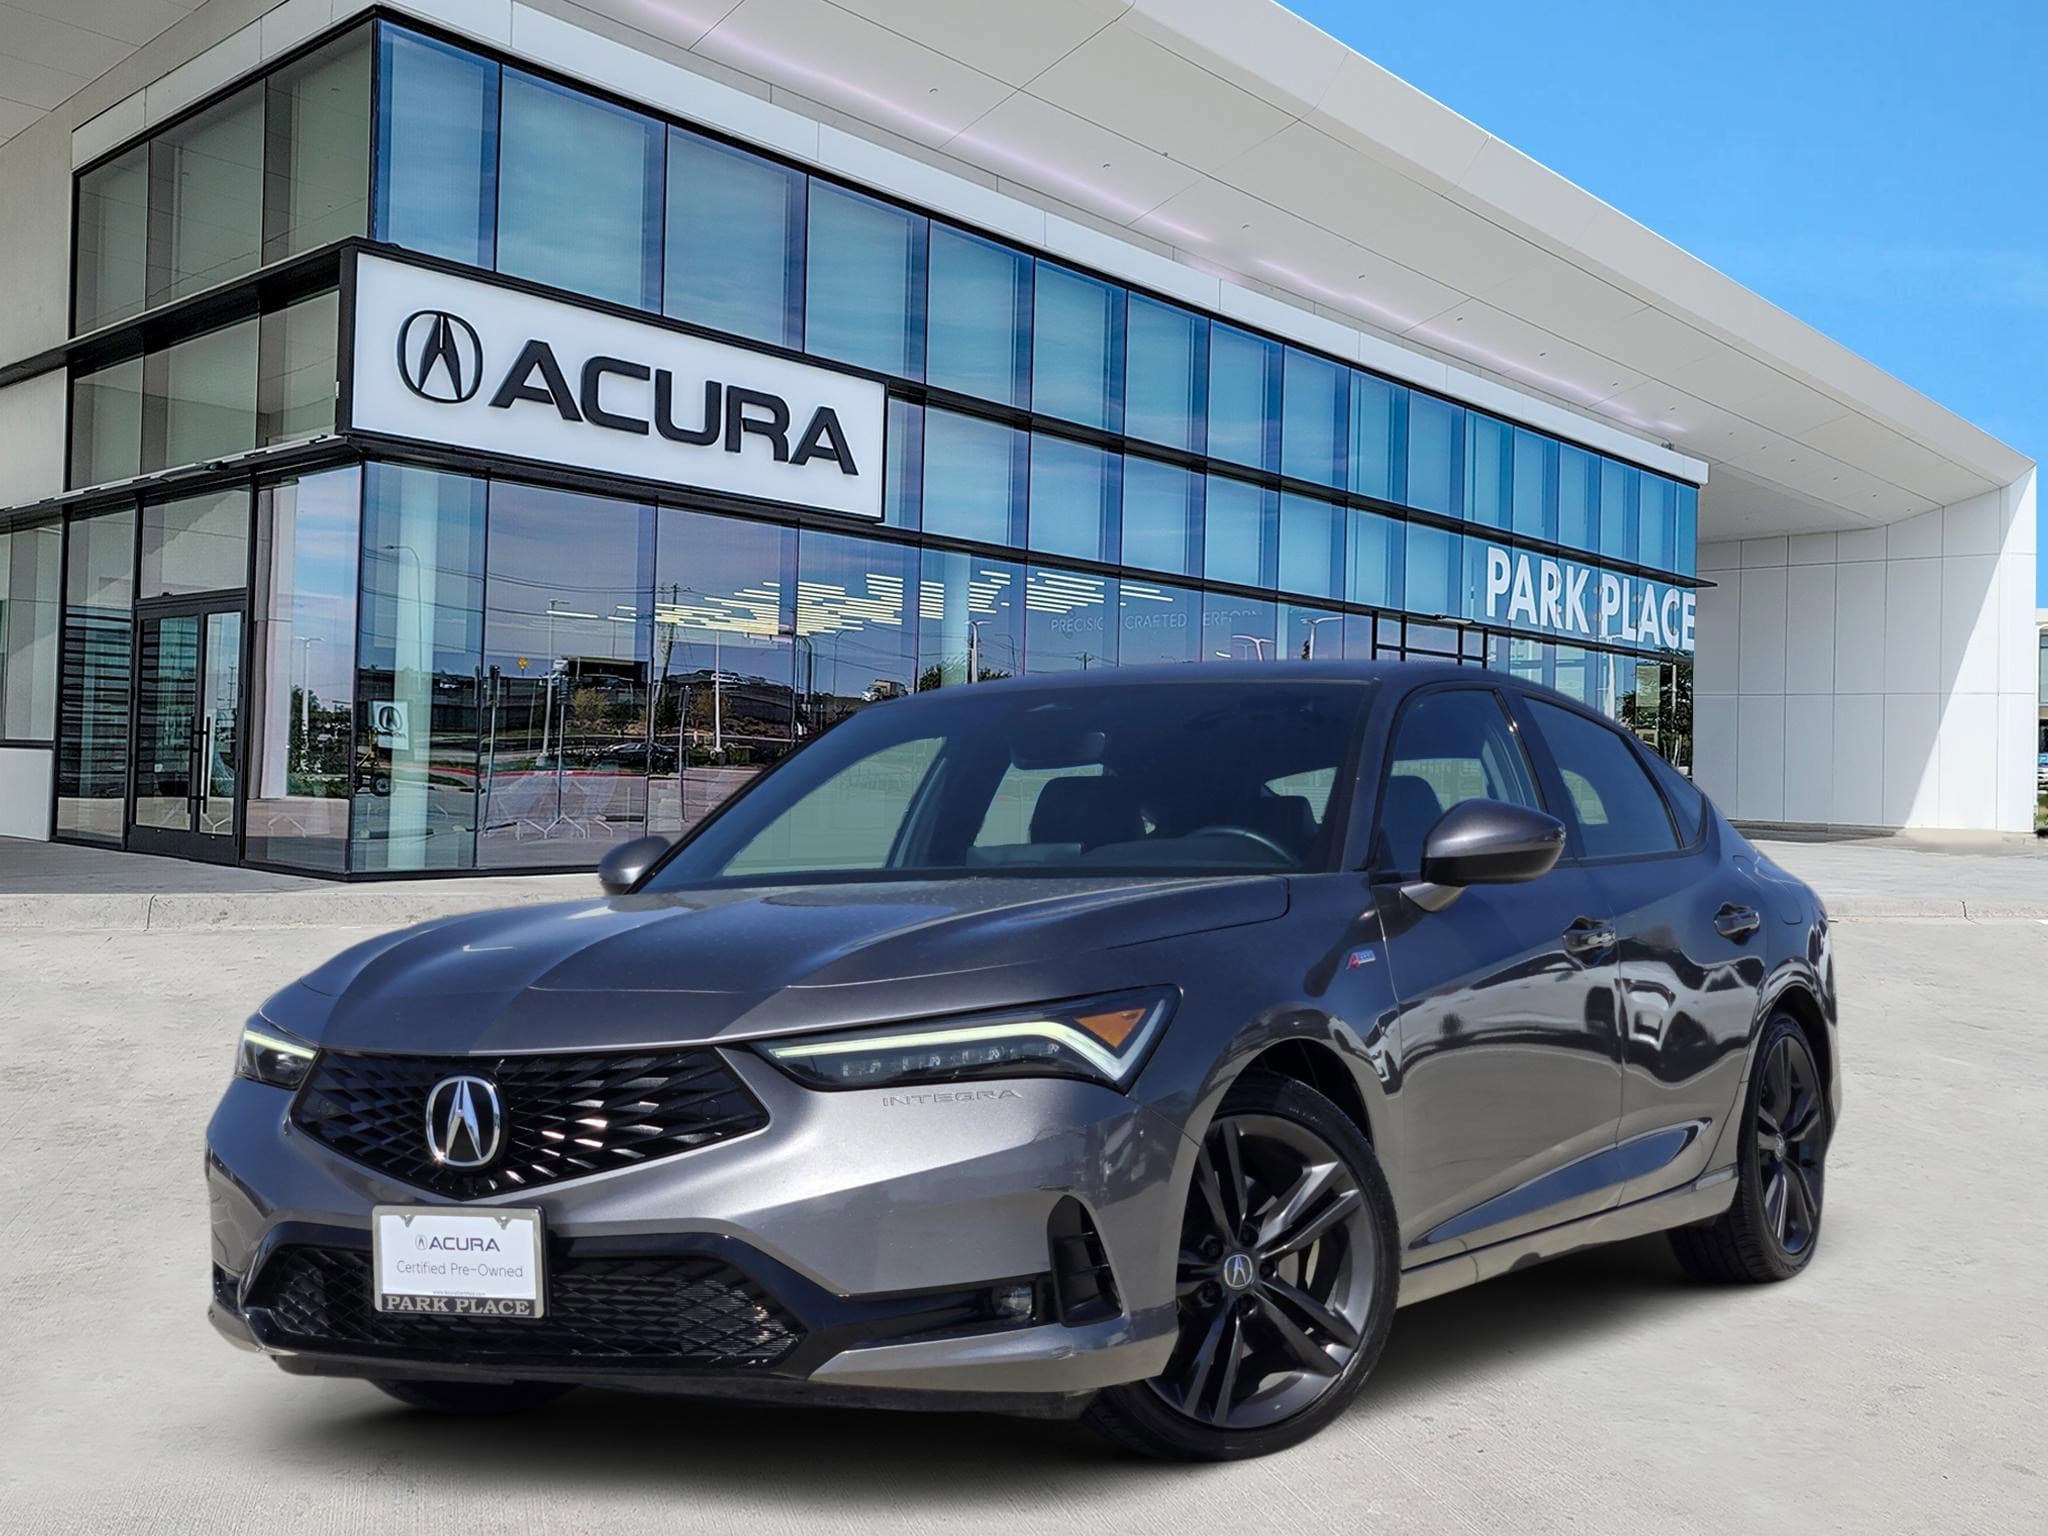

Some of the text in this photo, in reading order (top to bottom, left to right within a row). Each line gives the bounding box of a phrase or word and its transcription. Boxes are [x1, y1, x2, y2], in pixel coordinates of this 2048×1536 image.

[488, 338, 859, 476] ACURA
[1486, 546, 1696, 650] PARK PLACE
[1124, 613, 1187, 630] CRAFTED
[882, 1089, 1023, 1106] INTEGRA
[429, 1236, 501, 1252] ACURA
[396, 1260, 524, 1278] Certified Pre-Owned
[386, 1295, 530, 1315] PARK PLACE
